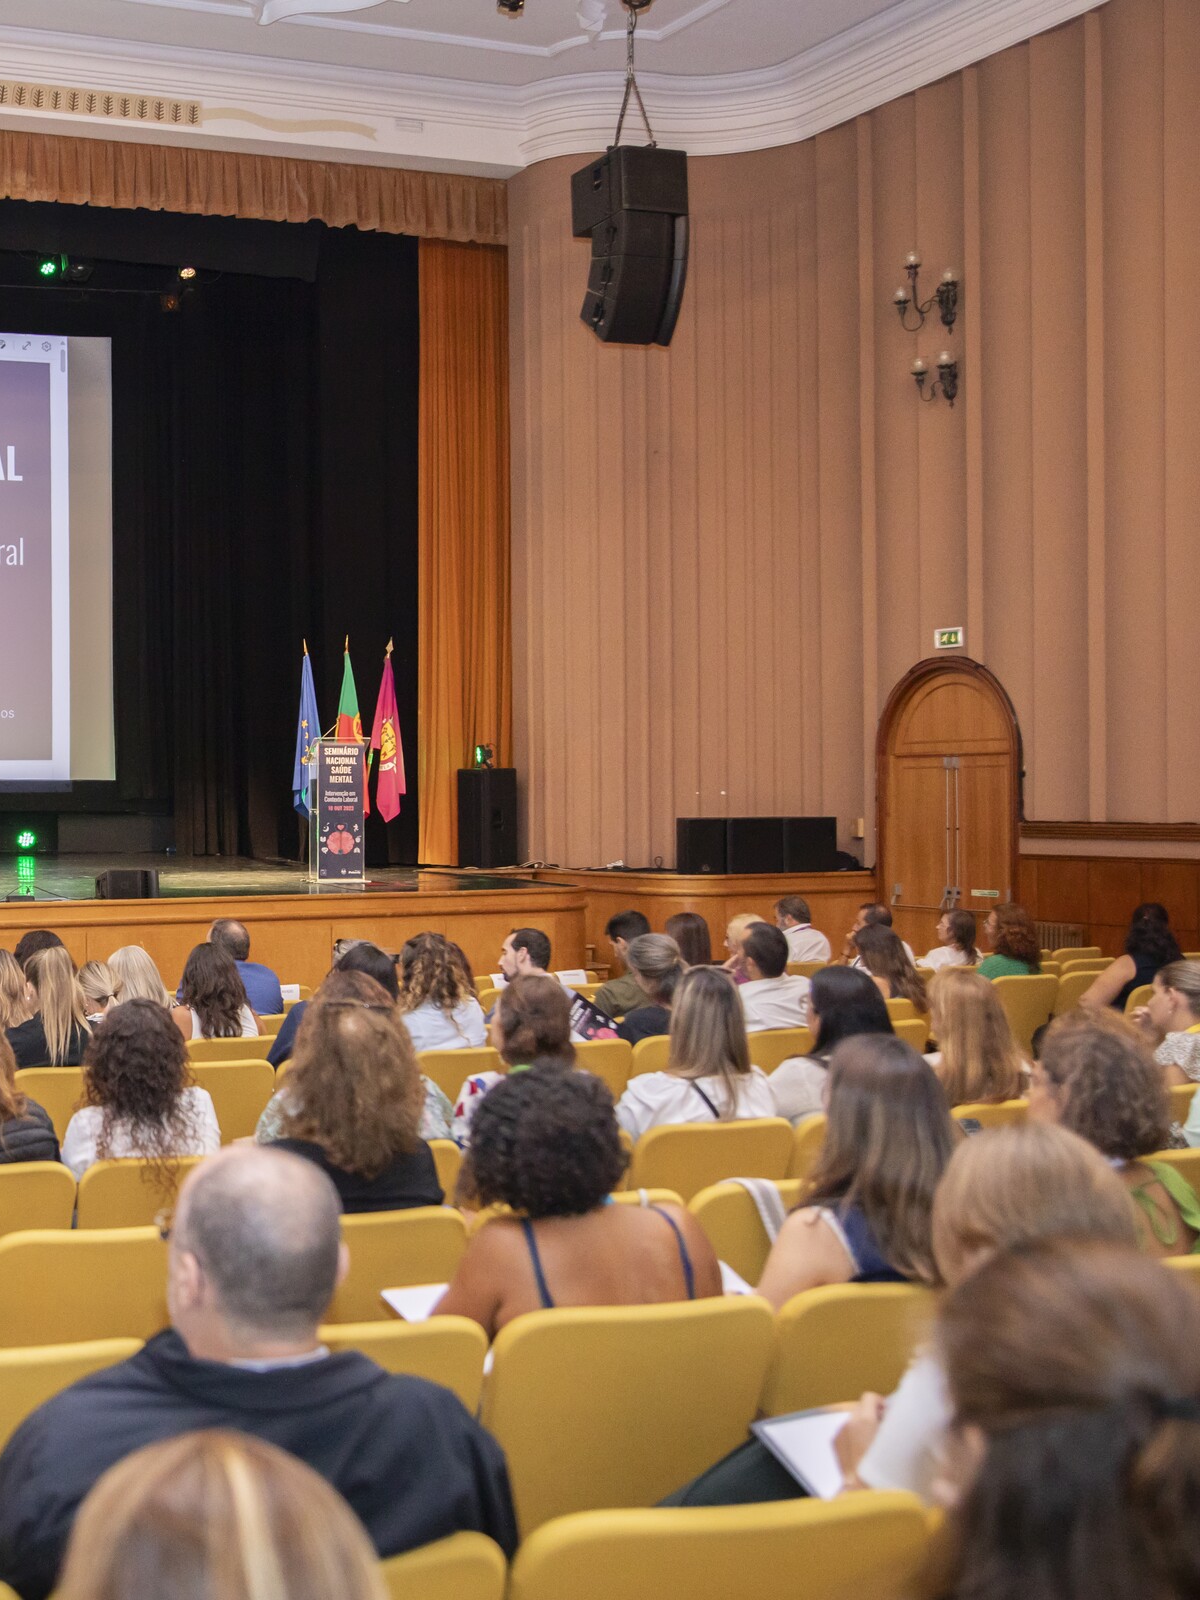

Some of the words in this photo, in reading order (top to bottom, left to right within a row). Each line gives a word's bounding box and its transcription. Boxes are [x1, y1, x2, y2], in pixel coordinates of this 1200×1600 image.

[324, 746, 359, 756] SEMINÁRIO
[325, 756, 357, 765] NACIONAL
[331, 764, 352, 774] SAÚDE
[329, 775, 353, 784] MENTAL
